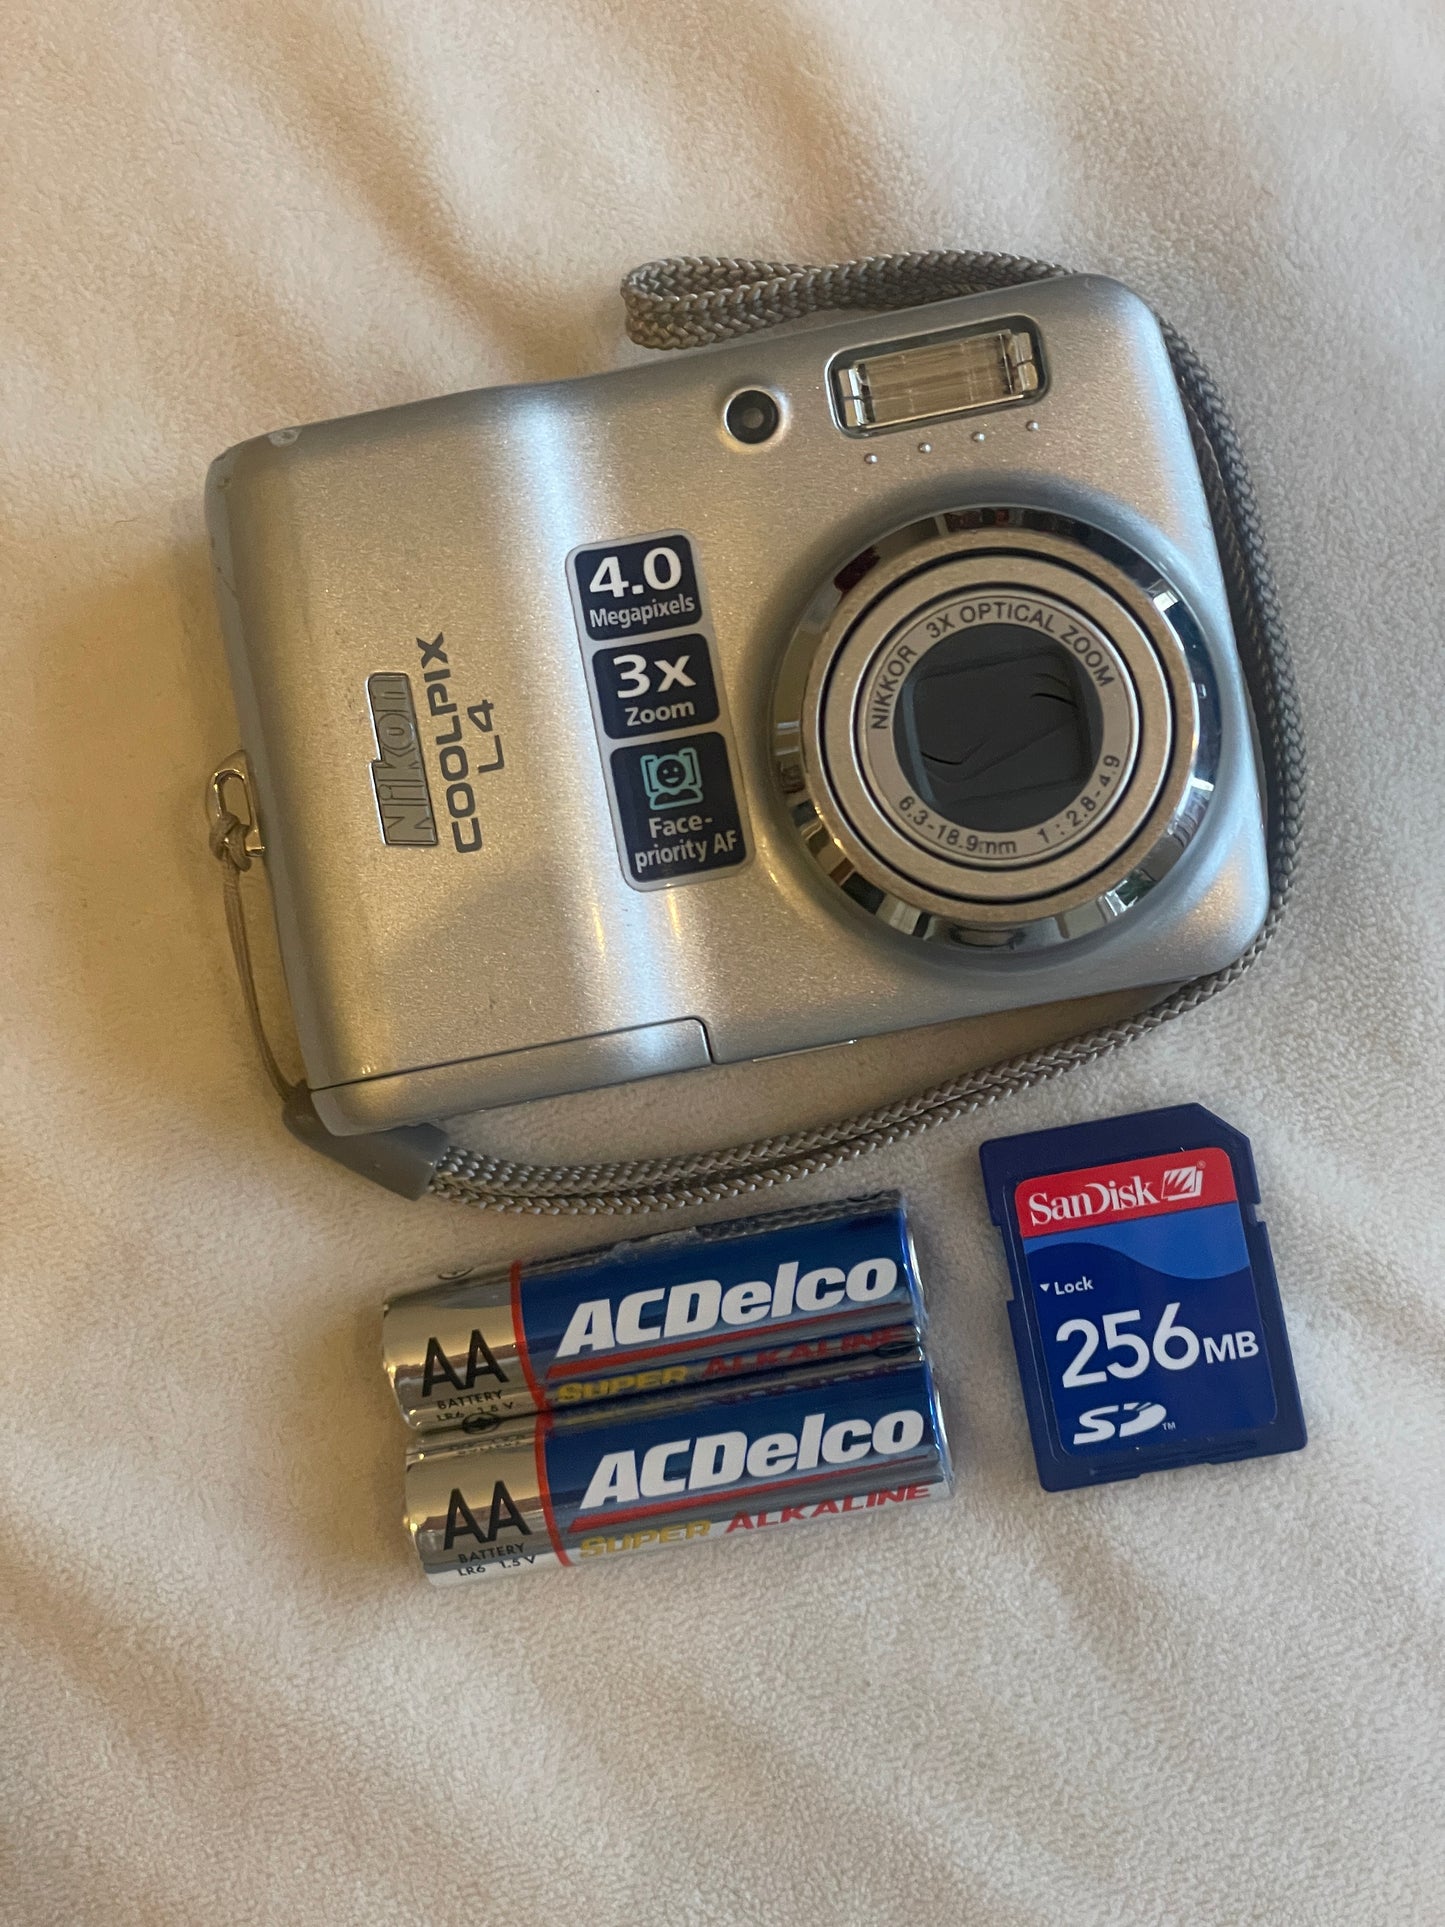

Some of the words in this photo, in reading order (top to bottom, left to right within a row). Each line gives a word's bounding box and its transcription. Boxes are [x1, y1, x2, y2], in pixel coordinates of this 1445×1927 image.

[589, 547, 682, 598] 4.0
[590, 594, 695, 628] Megapixels
[613, 653, 697, 699] 3x
[871, 644, 918, 730] NIKKOR
[926, 613, 956, 639] 3X
[960, 602, 1055, 633] OPTICAL
[1060, 625, 1115, 688] ZOOM
[467, 699, 505, 774] L4
[625, 701, 696, 727] Zoom
[373, 674, 437, 843] Nikon
[416, 631, 483, 854] COOLPIX
[634, 838, 708, 873] priority
[713, 829, 739, 855] AF
[648, 815, 713, 839] Face-
[899, 796, 1017, 855] 6.3-18.9mm
[1028, 1175, 1161, 1227] SanDisk
[555, 1257, 898, 1360] ACDelco
[1054, 1275, 1094, 1296] Lock
[421, 1328, 510, 1398] AA
[556, 1365, 690, 1404] SUPER
[436, 1389, 503, 1411] BATTERY
[579, 1409, 925, 1511] ACDelco
[443, 1479, 533, 1551] AA
[579, 1519, 713, 1559] SUPER
[724, 1483, 933, 1535] ALKALINE
[456, 1564, 486, 1577] LR6
[457, 1542, 525, 1564] BATTERY
